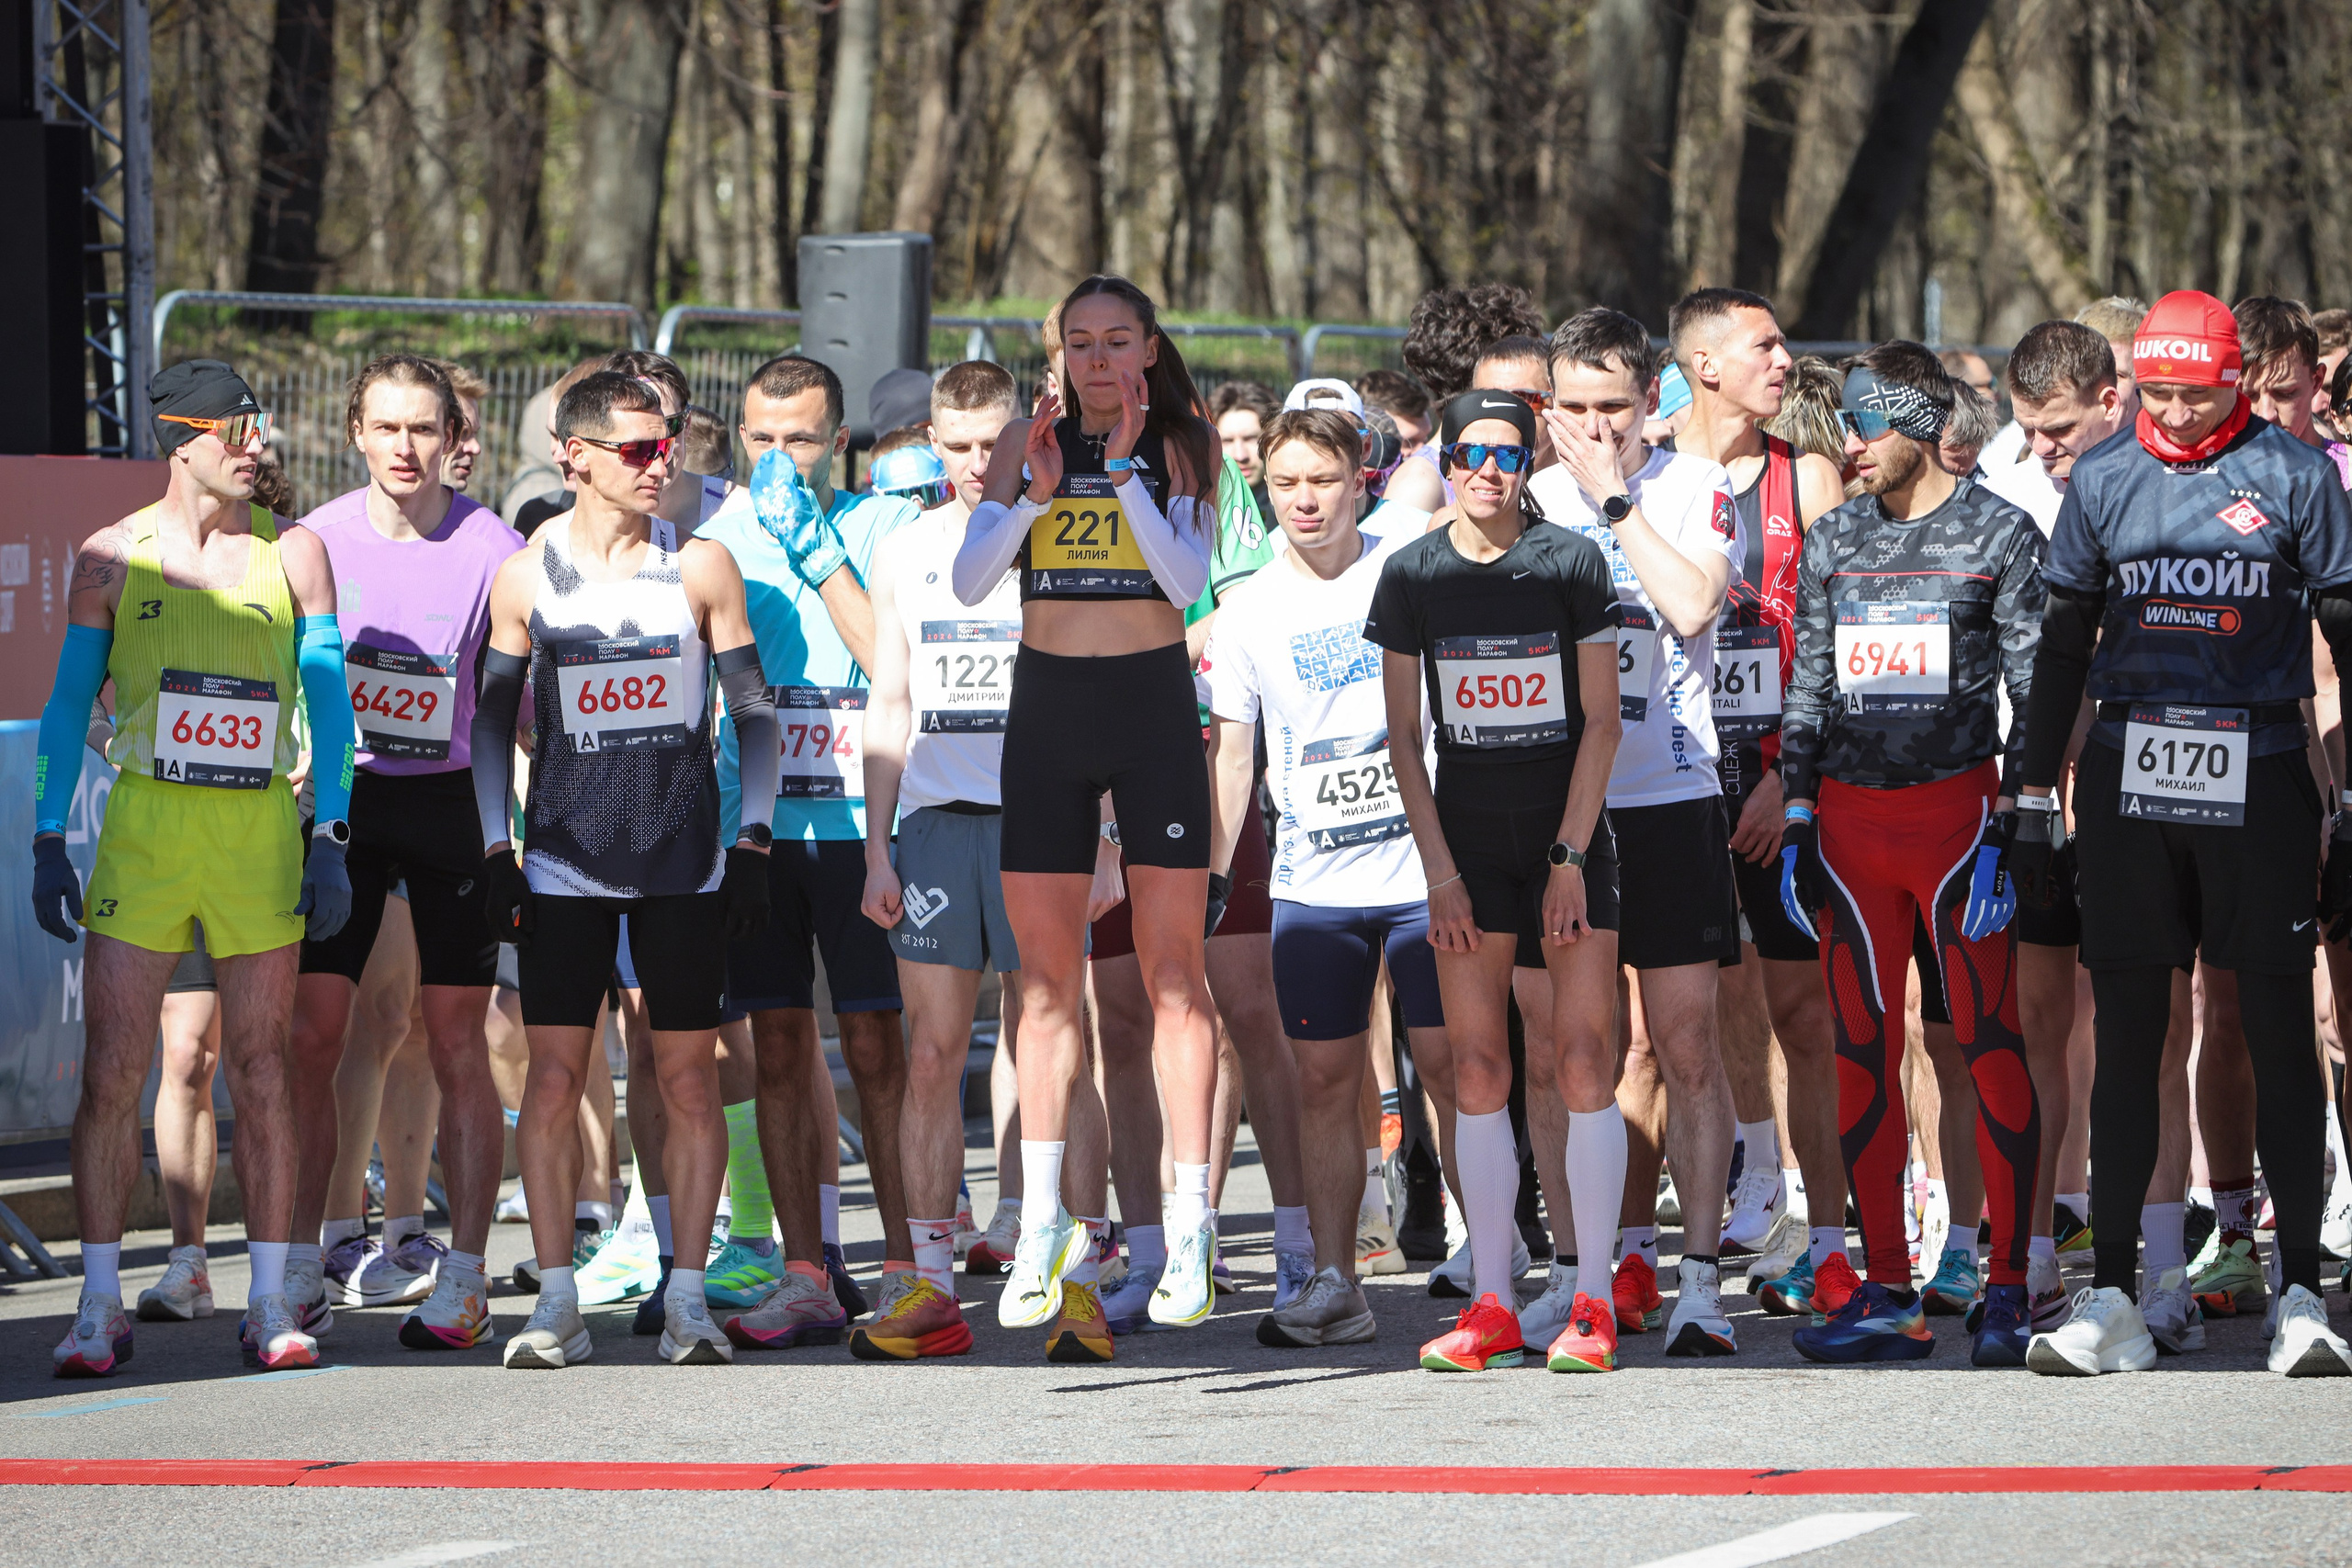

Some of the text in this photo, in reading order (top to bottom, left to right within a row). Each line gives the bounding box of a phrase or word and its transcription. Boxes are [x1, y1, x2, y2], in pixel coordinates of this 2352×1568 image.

[2133, 340, 2212, 362] LUKOIL
[1055, 510, 1119, 547] 221
[1767, 528, 1792, 537] ORAZ
[660, 529, 668, 566] INSANITY
[1067, 549, 1108, 560] ЛИЛИЯ
[2119, 550, 2270, 597] ЛУКОЙЛ
[2145, 605, 2217, 628] WINLINE
[598, 640, 639, 649] МОСКОВСКИЙ
[378, 651, 418, 662] МОСКОВСКИЙ
[378, 657, 394, 665] ПОЛУ
[1849, 642, 1927, 676] 6941
[377, 662, 406, 671] МАРАФОН
[935, 654, 1017, 688] 1221
[168, 683, 197, 693] 2026
[203, 677, 242, 687] МОСКОВСКИЙ
[578, 674, 667, 715] 6682
[948, 691, 1004, 704] ДМИТРИЙ
[1456, 672, 1547, 709] 6502
[351, 681, 438, 722] 6429
[1668, 635, 1692, 773] are the best
[1712, 698, 1741, 709] ITALI
[2165, 706, 2207, 716] МОСКОВСКИЙ
[2135, 714, 2160, 723] 2026
[2165, 718, 2194, 727] МАРАФОН
[172, 710, 263, 750] 6633
[1305, 752, 1330, 762] 2026
[2138, 737, 2229, 779] 6170
[1317, 761, 1399, 807] 4525
[2155, 778, 2205, 792] МИХАИЛ
[1341, 800, 1390, 818] МИХАИЛ
[912, 936, 938, 949] 2012
